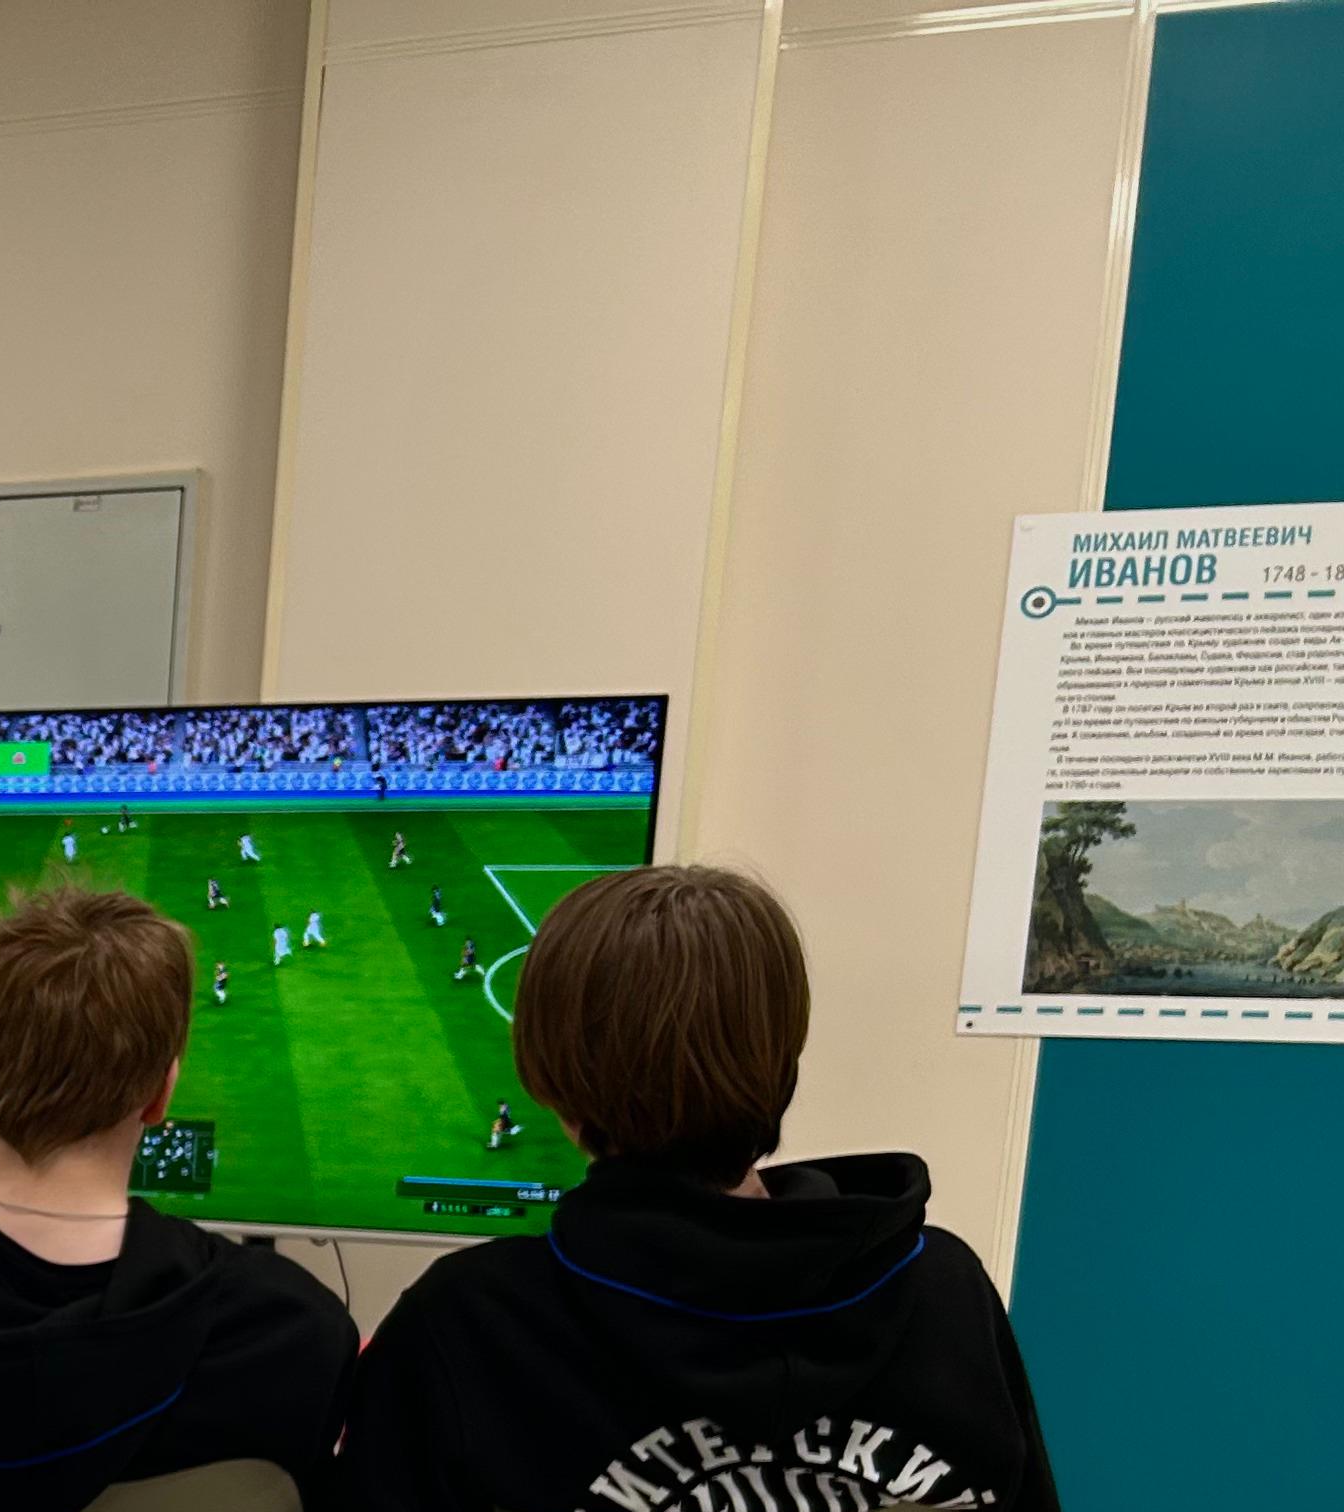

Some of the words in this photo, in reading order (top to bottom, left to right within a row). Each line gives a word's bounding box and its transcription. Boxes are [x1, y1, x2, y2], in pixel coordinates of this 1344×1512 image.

[1072, 530, 1169, 553] МИХАИЛ
[1176, 525, 1313, 549] МАТВЕЕВИЧ
[1067, 553, 1218, 589] ИВАНОВ
[1263, 564, 1306, 583] 1748
